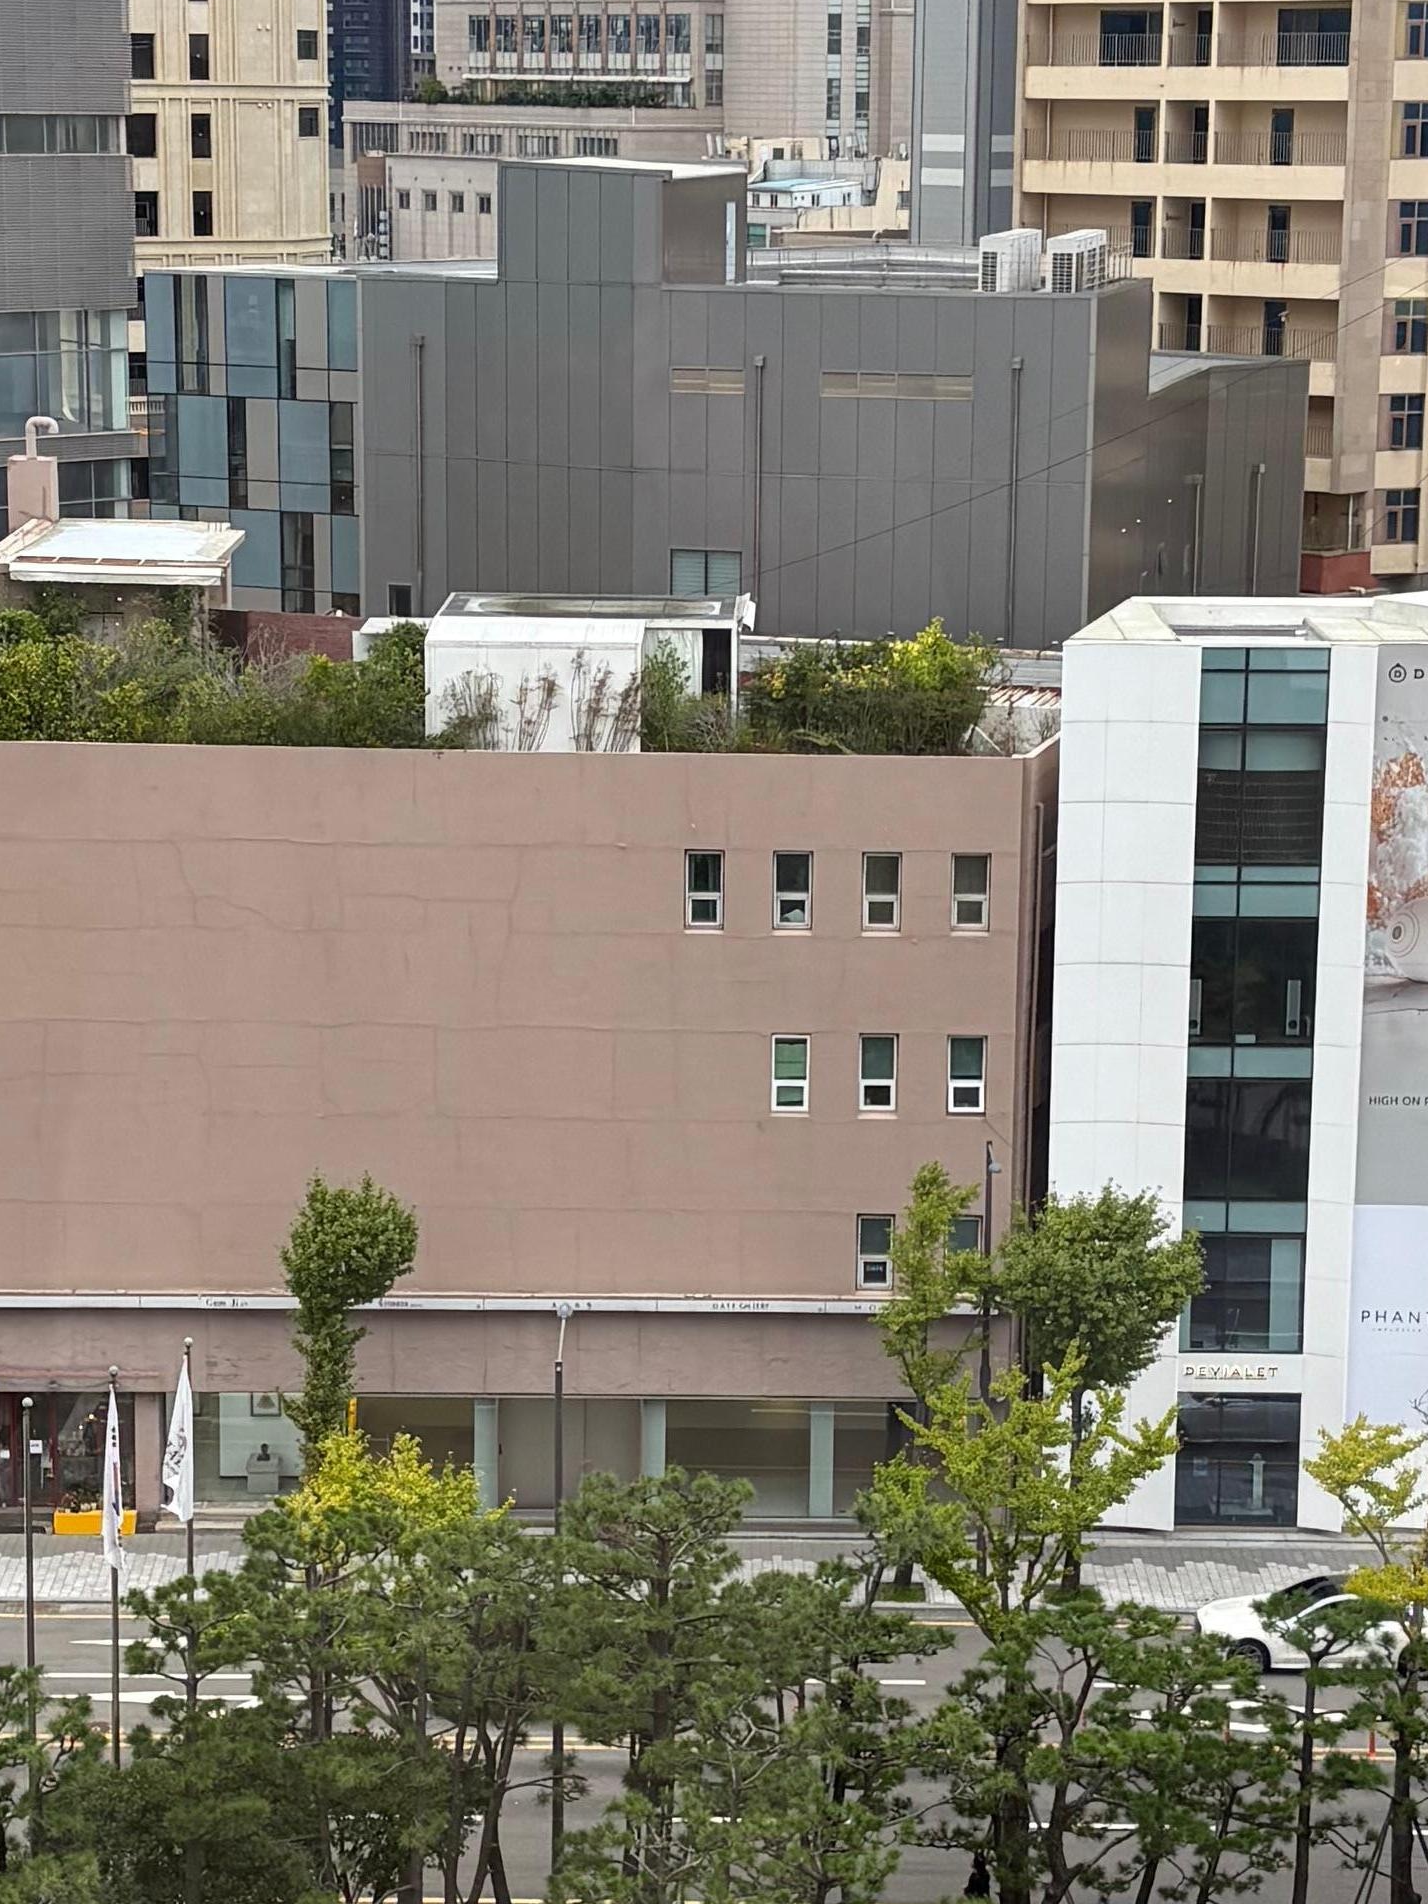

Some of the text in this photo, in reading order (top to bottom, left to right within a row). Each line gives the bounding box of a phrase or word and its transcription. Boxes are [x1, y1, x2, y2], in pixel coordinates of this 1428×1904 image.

[1368, 1095, 1399, 1106] HIGH
[1402, 1096, 1421, 1106] ON
[1184, 1365, 1279, 1378] DEVIALET
